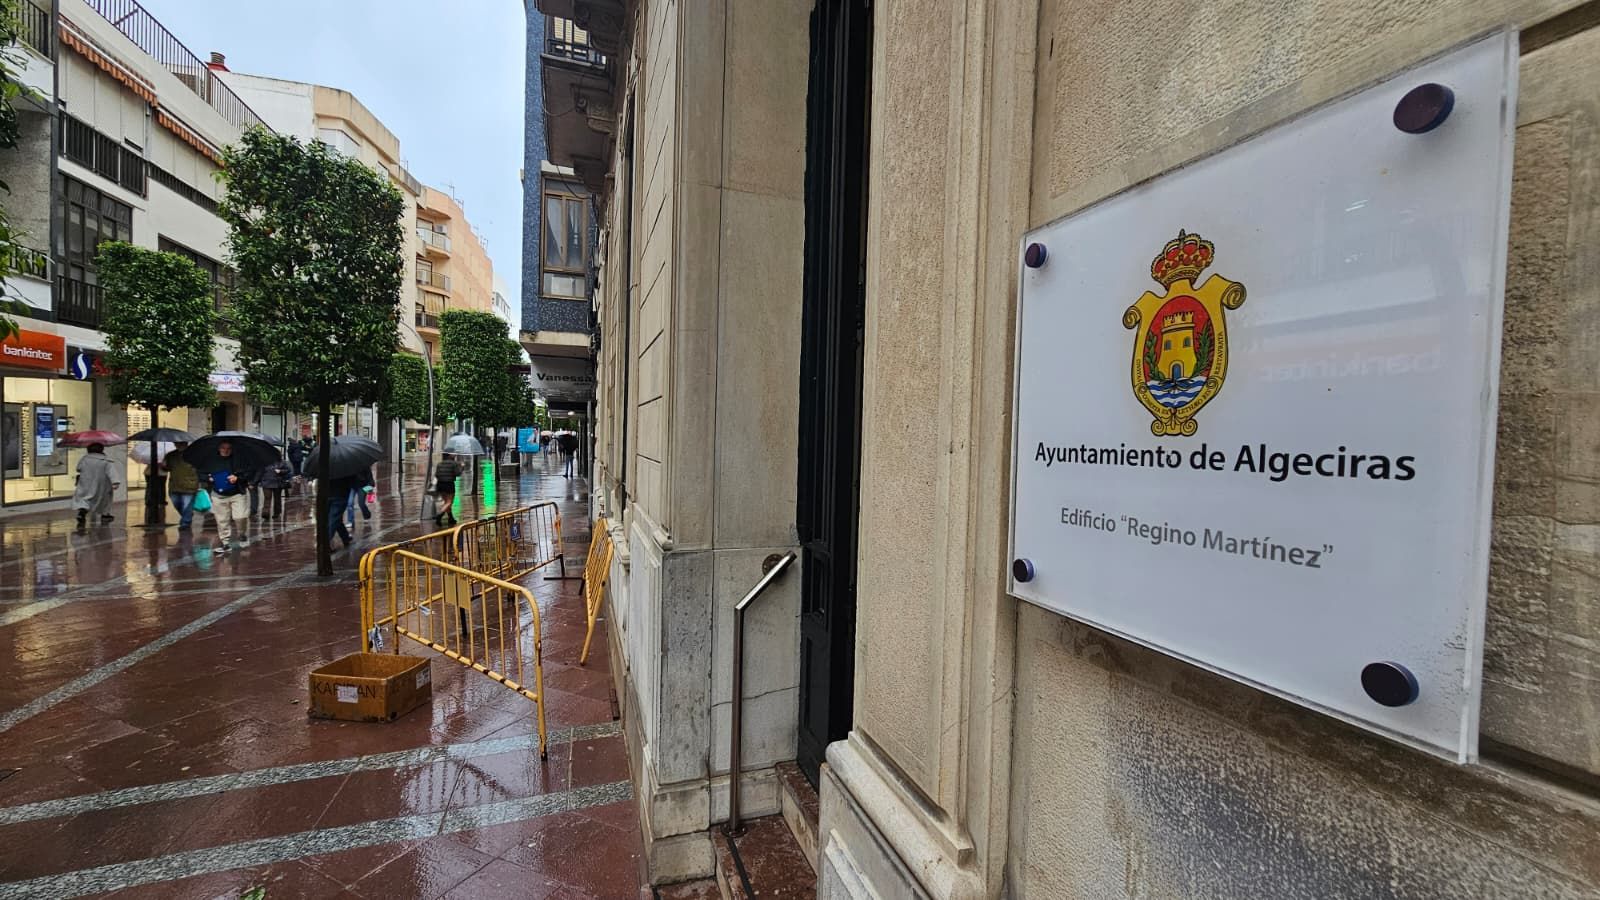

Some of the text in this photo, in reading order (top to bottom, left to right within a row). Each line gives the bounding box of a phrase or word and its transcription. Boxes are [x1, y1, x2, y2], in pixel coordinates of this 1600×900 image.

[537, 373, 592, 382] Vanessa
[1035, 442, 1417, 483] Ayuntamiento de Algeciras
[1060, 507, 1334, 569] Edificio “Regino Martínez”
